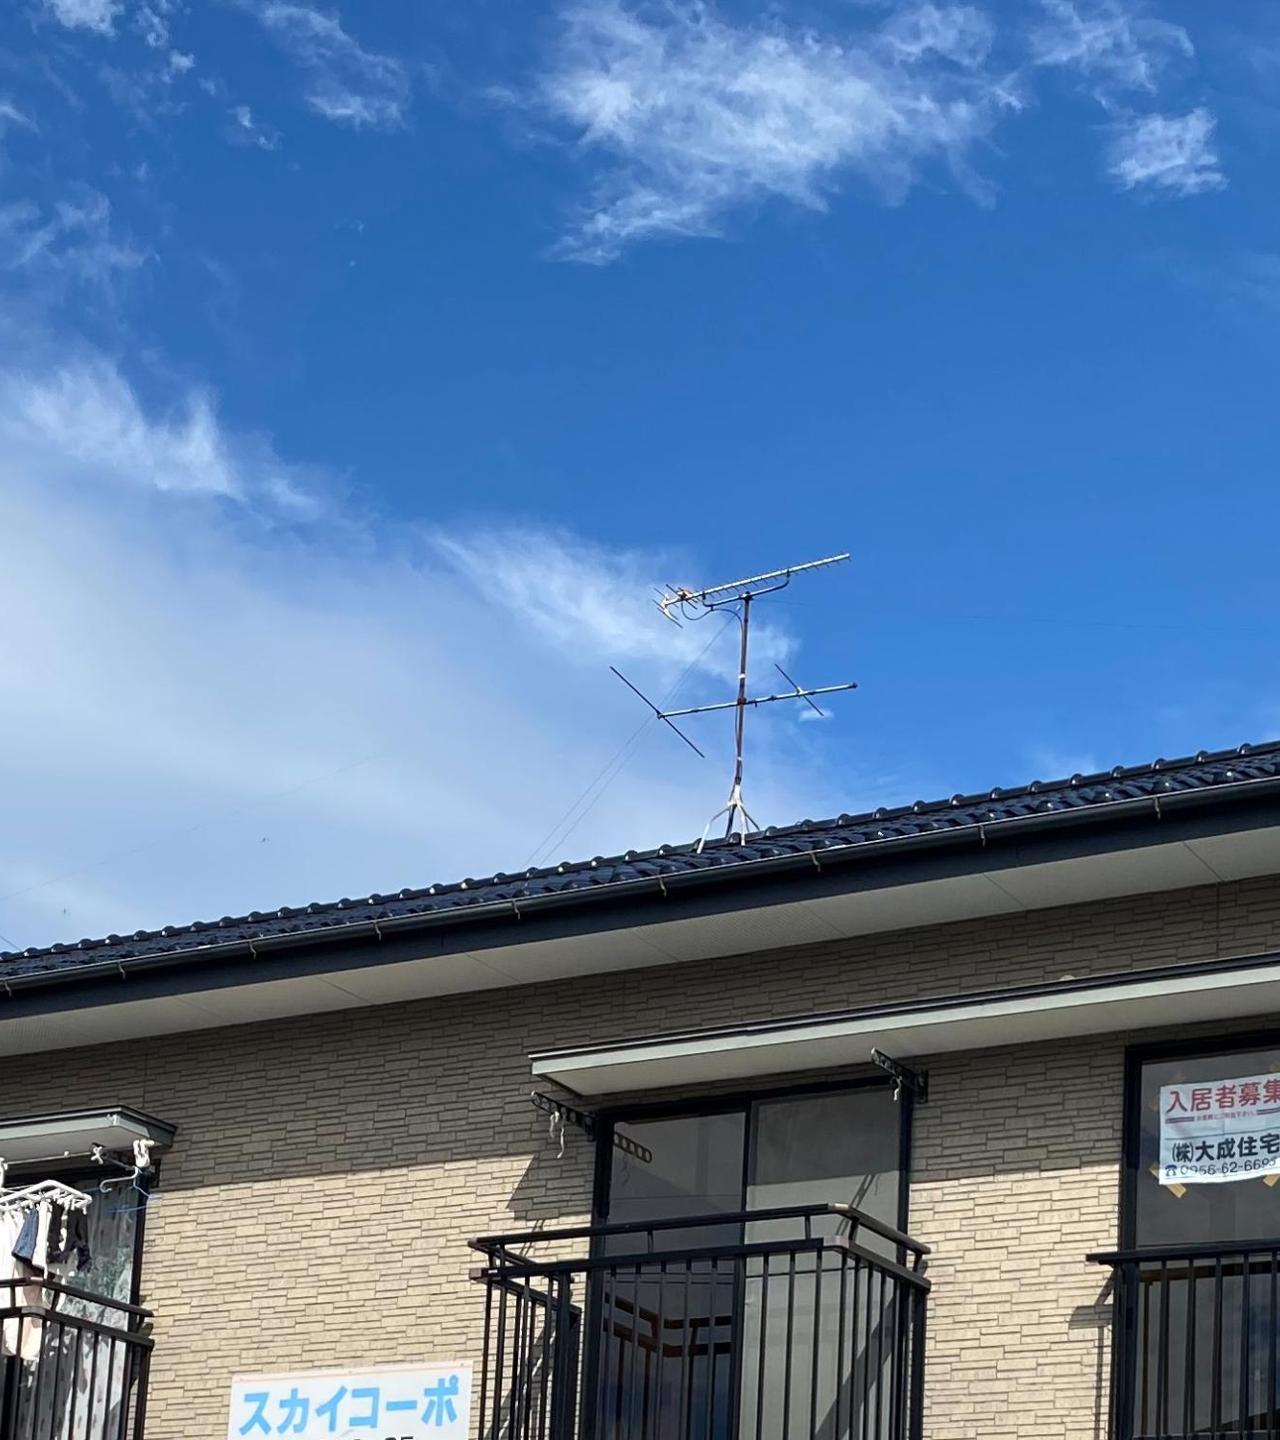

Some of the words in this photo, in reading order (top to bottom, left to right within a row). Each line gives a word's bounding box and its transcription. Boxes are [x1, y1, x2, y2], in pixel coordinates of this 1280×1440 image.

[239, 1374, 459, 1435] スカイコーポ
